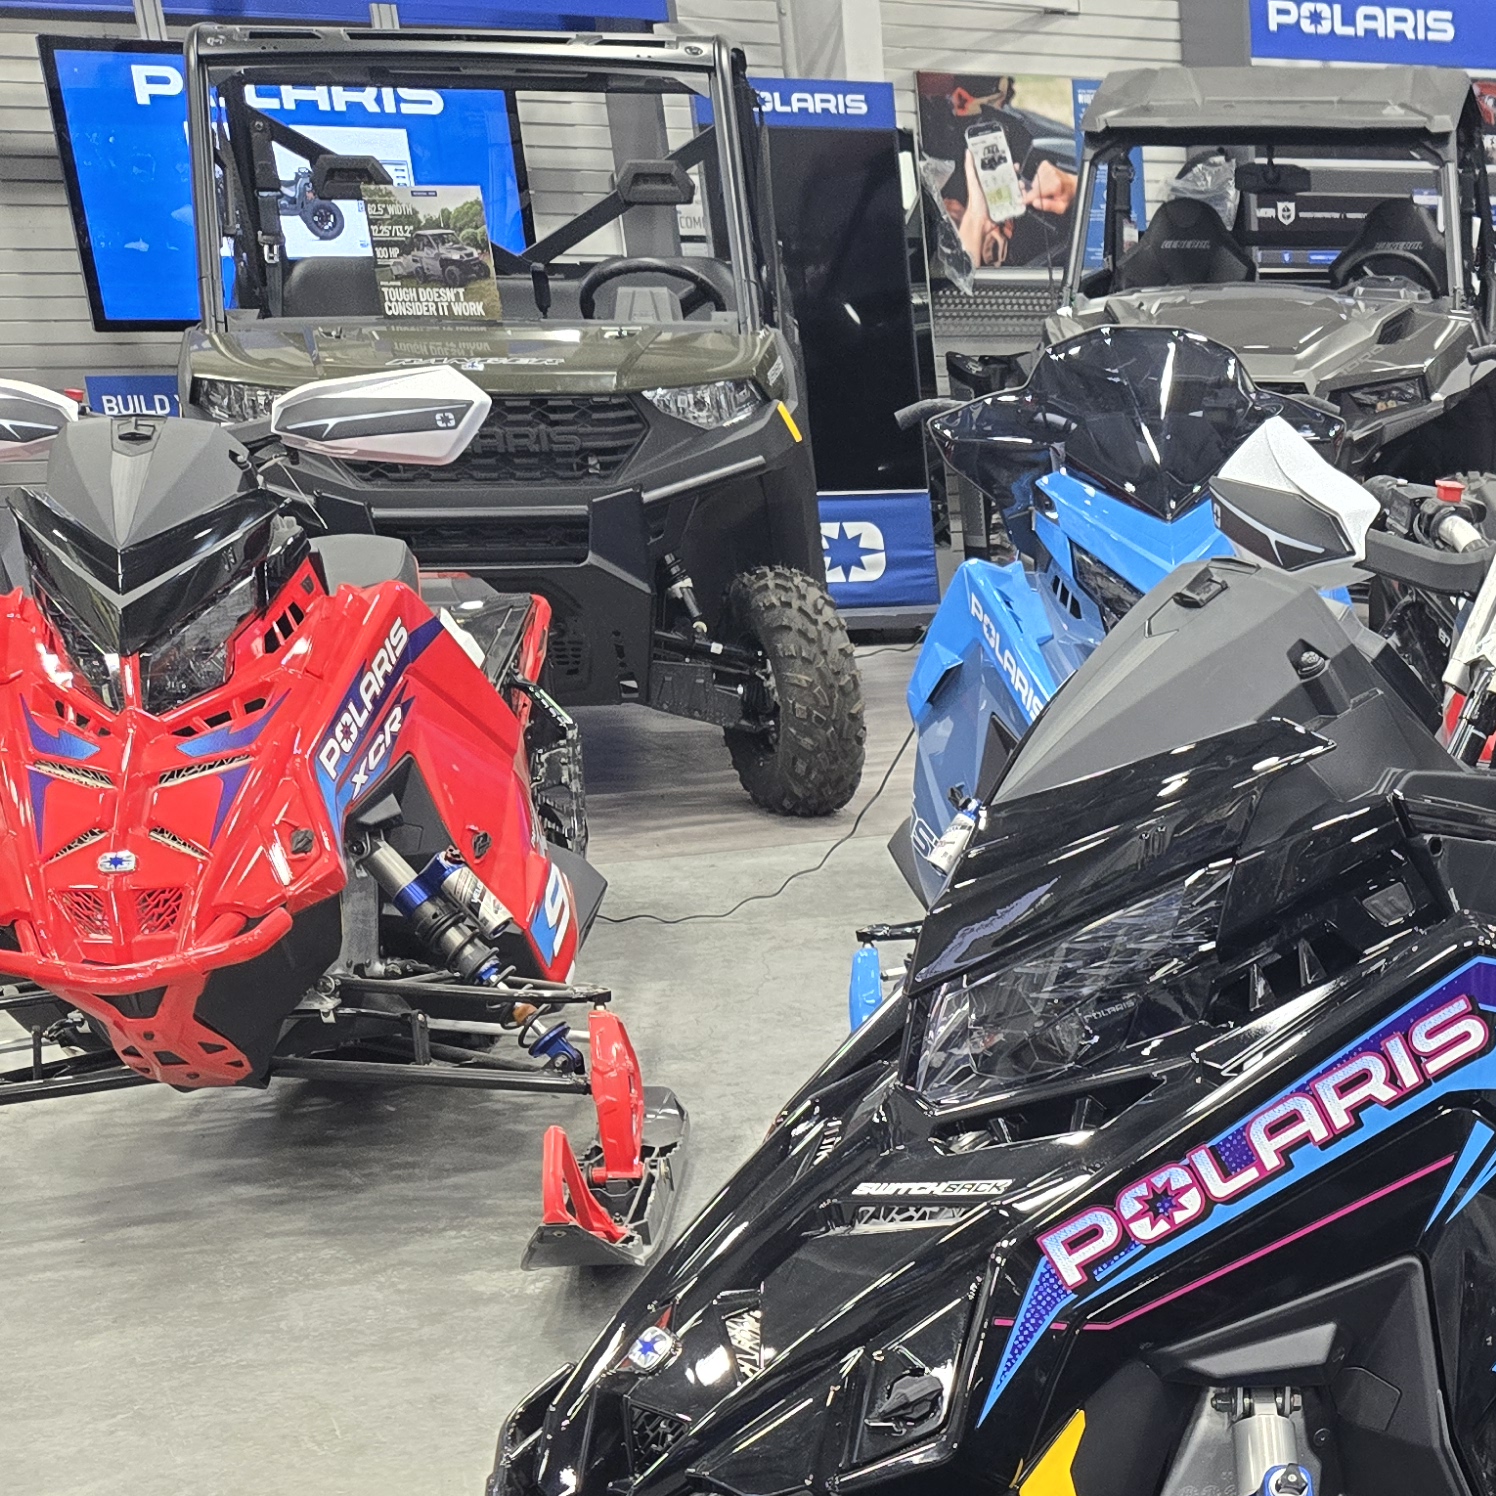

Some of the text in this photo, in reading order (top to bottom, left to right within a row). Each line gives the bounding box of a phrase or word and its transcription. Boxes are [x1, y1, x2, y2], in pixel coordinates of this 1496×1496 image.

[1268, 1, 1455, 42] POLARIS
[130, 65, 444, 115] PLARIS
[753, 91, 868, 115] OLARIS
[388, 204, 413, 215] WIDTH
[375, 247, 399, 259] 100 HP
[382, 288, 465, 301] TOUGH DOESN'T
[384, 302, 485, 316] CONSIDER IT WORK
[102, 395, 170, 415] BUILD
[474, 426, 580, 453] ARIS
[318, 616, 408, 781] POLARIS
[351, 705, 401, 800] XCR
[1037, 993, 1489, 1294] POLARIS
[851, 1179, 1014, 1195] SWITCHBACK
